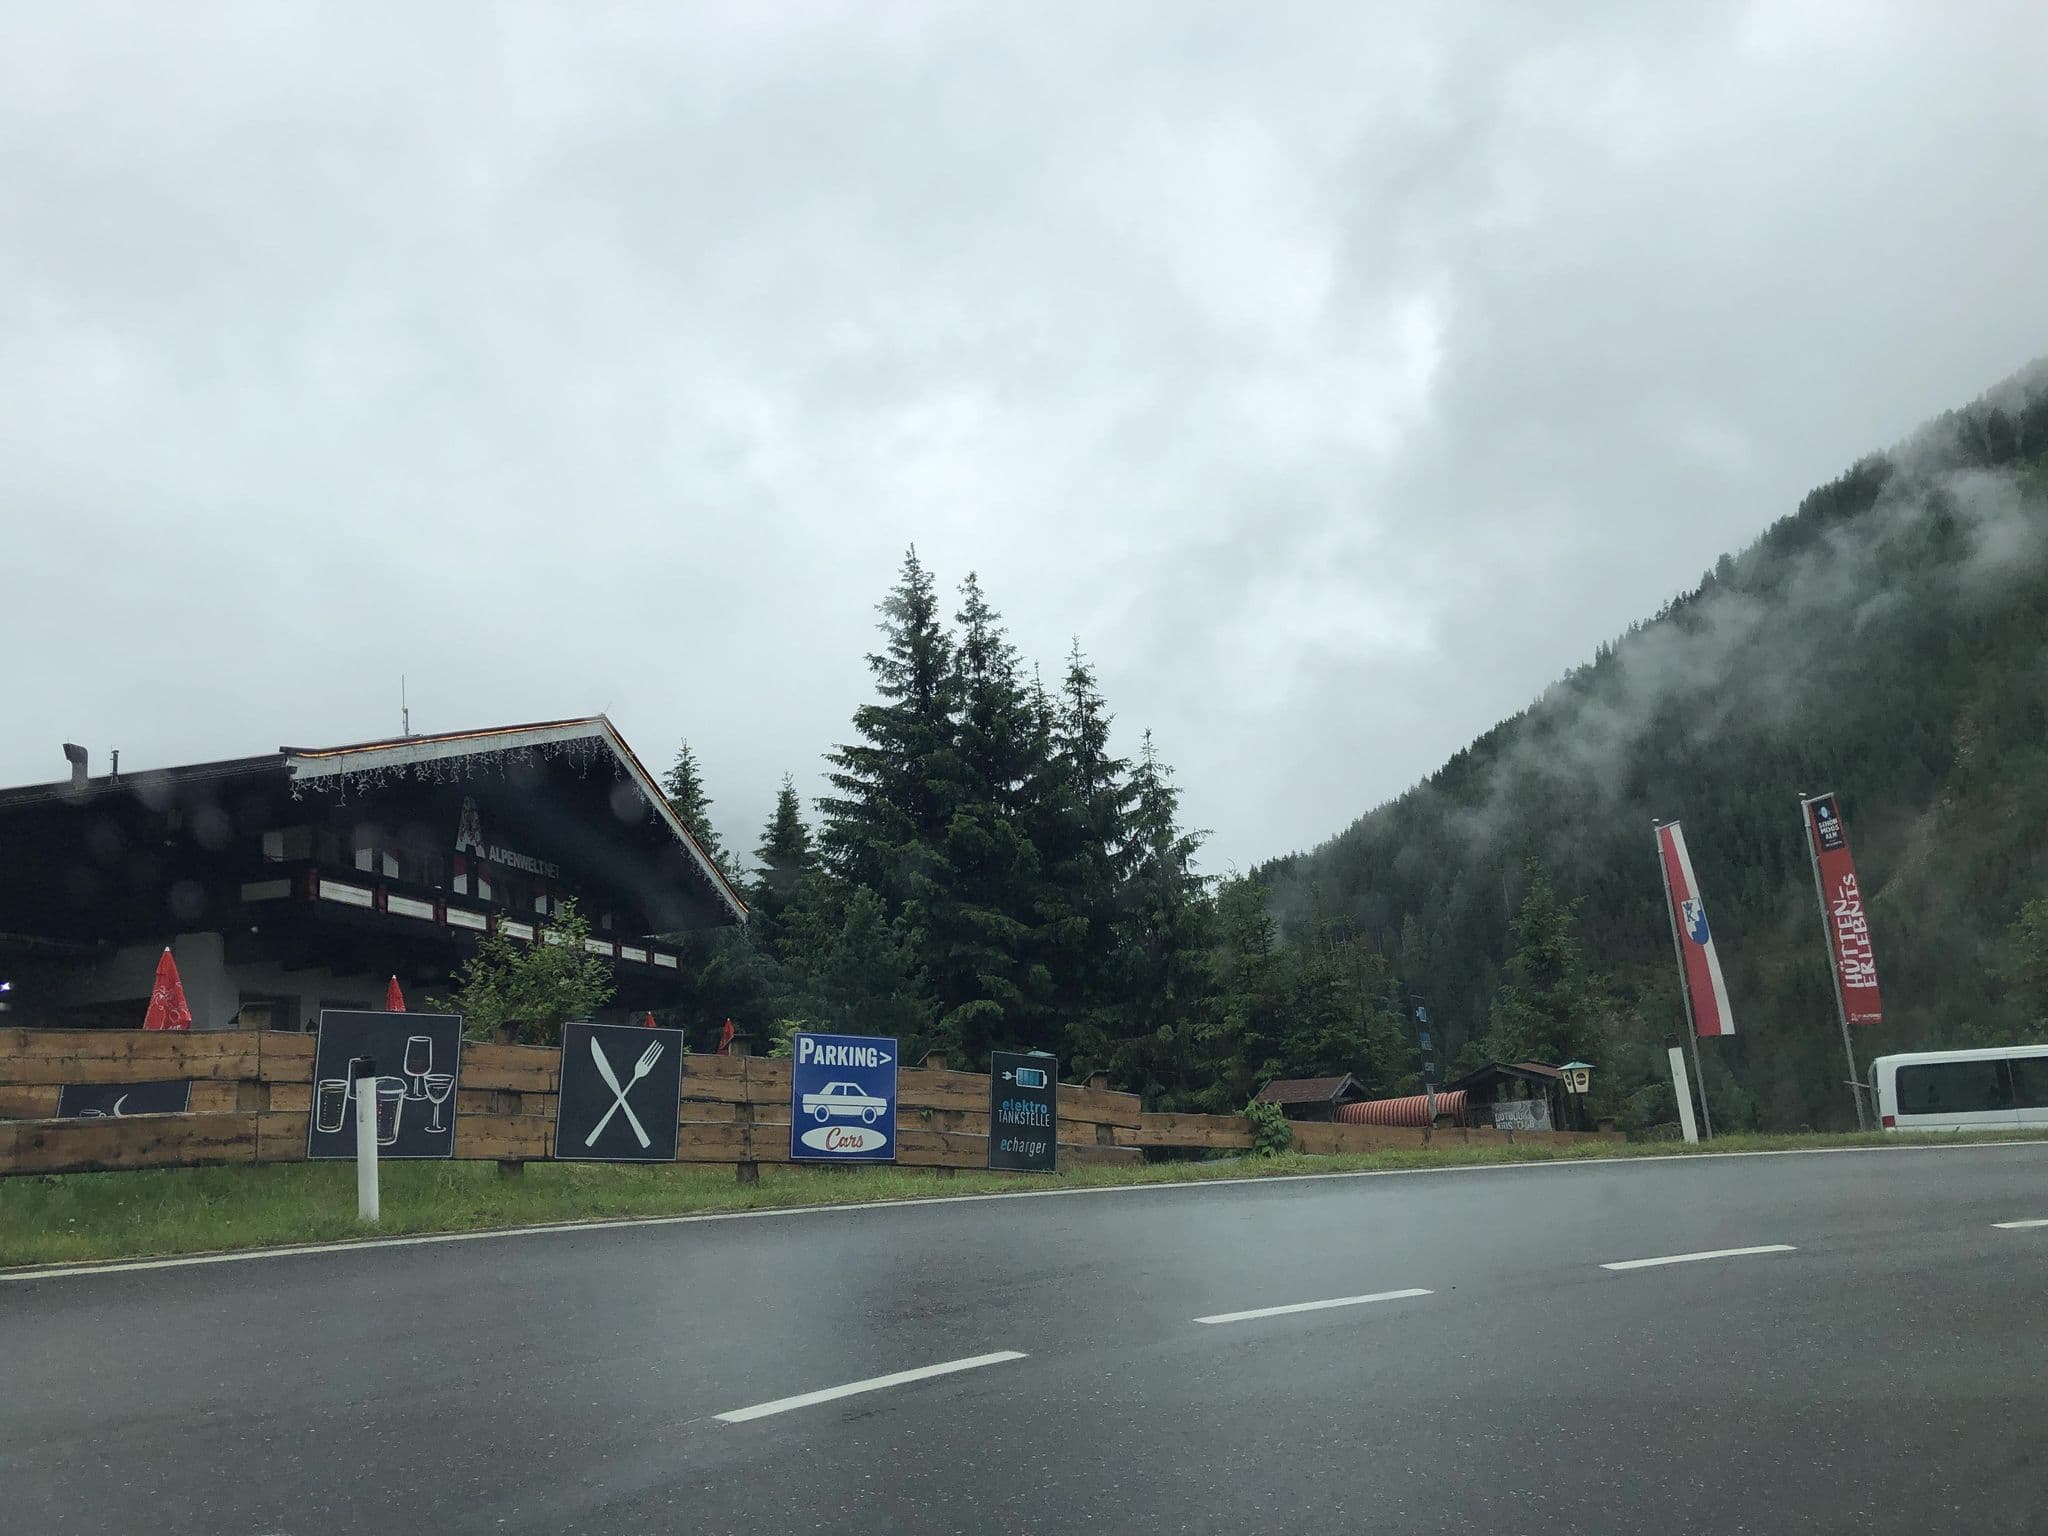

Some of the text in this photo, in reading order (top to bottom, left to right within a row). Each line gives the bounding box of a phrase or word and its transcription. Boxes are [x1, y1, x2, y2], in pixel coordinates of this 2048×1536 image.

[1843, 873, 1877, 987] ERLEBNIS
[799, 1038, 878, 1068] PARKING
[1002, 1099, 1048, 1114] elektro
[998, 1110, 1050, 1128] TANKSTELLE
[825, 1127, 864, 1151] Cars
[1000, 1137, 1047, 1157] echarger
